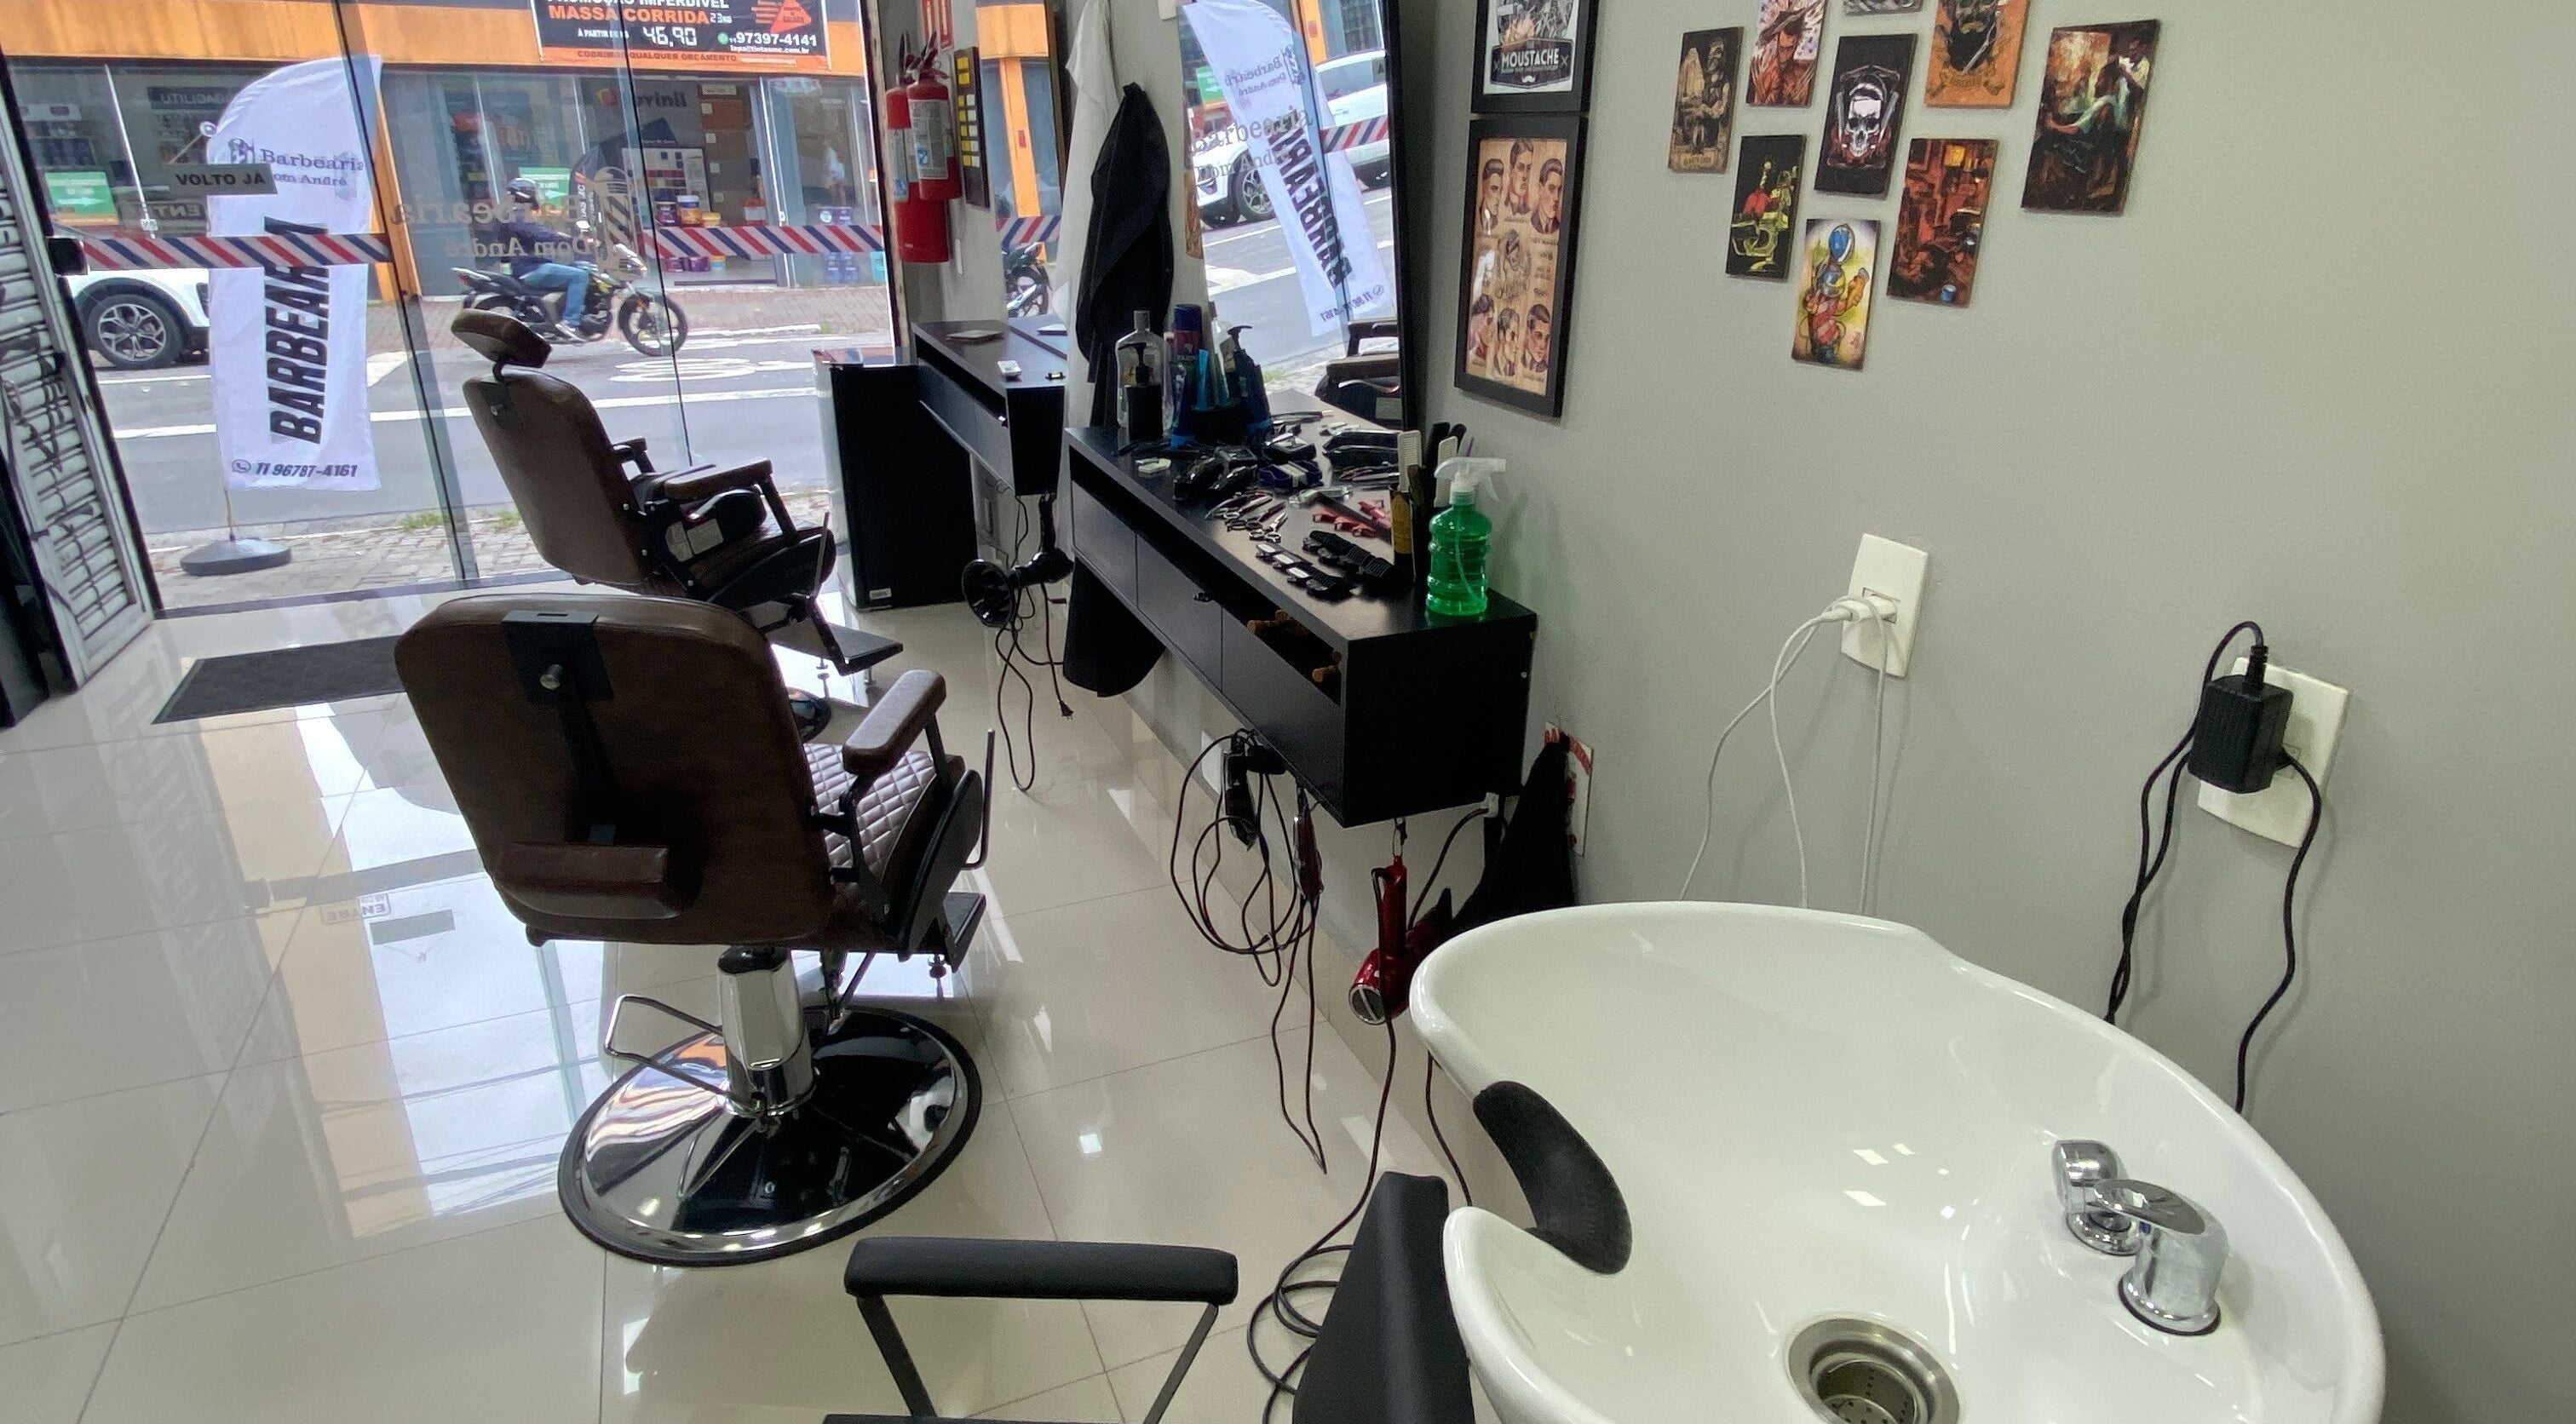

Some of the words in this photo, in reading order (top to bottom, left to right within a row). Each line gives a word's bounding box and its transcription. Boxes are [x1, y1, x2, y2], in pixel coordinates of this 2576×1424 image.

[549, 5, 618, 21] MASSA
[624, 9, 710, 24] CORRIDA
[643, 26, 698, 47] 46,90
[736, 32, 818, 46] 97397-4141
[1502, 49, 1560, 69] MOUSTACHE
[175, 174, 238, 186] VOLTO
[273, 173, 301, 184] om
[272, 463, 359, 478] 96787-4161
